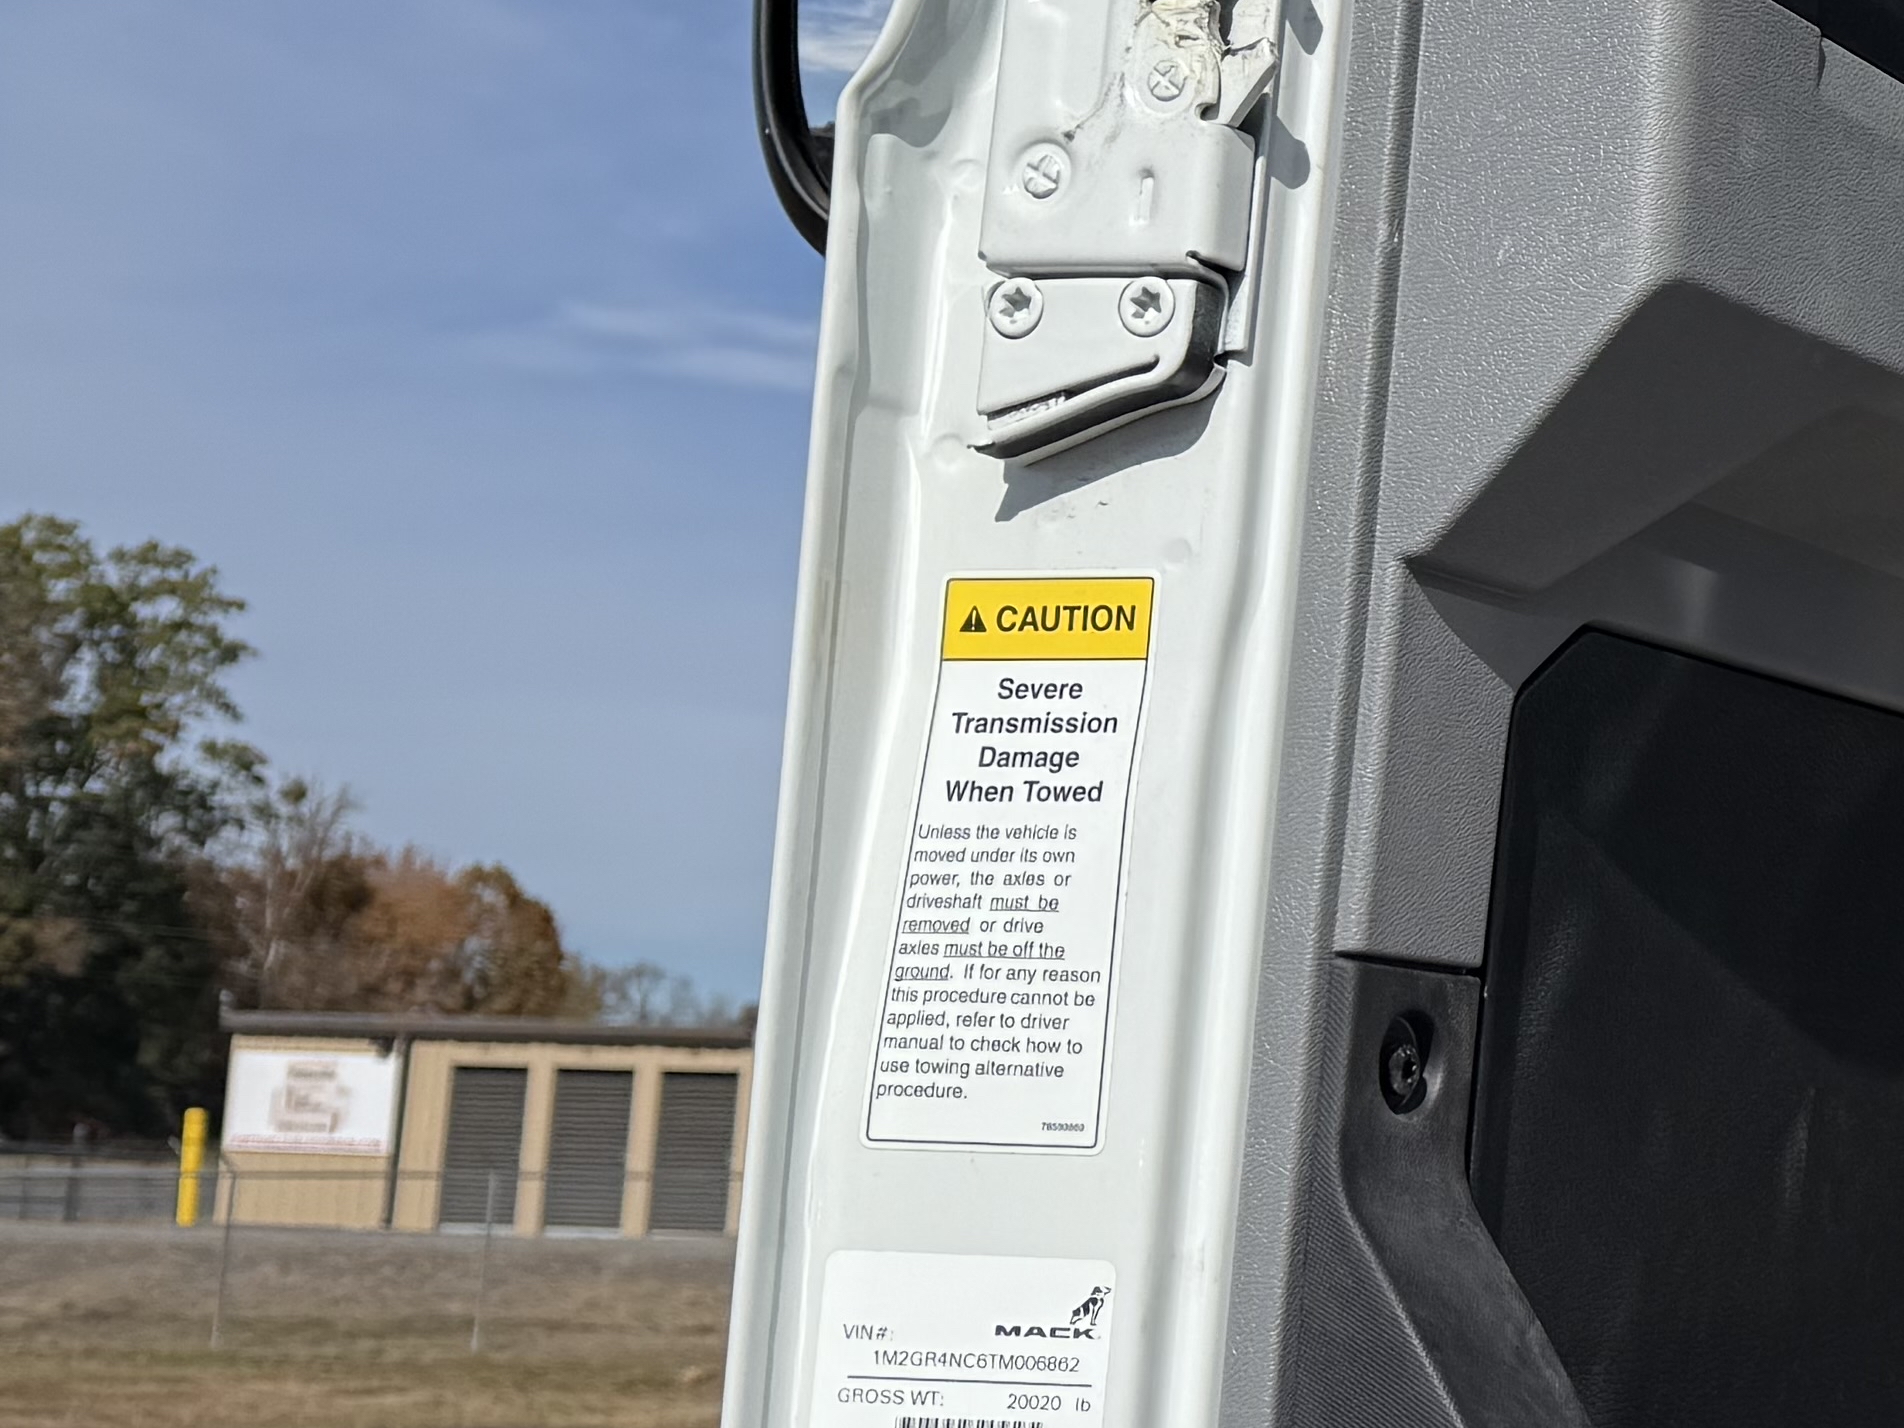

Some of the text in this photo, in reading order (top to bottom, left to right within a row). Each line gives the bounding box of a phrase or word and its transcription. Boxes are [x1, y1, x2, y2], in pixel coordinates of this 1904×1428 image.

[995, 604, 1136, 632] CAUTION
[997, 677, 1083, 700] Severe
[951, 710, 1118, 734] Transmission
[977, 745, 1080, 774] Damage
[945, 779, 1104, 802] When Towed
[917, 823, 1077, 840] Unless the vehicle is
[913, 846, 1075, 863] moved under its own
[908, 870, 1072, 888] power, the axles or
[906, 892, 1059, 911] driveshaft must be
[901, 916, 1044, 934] removed or drive
[897, 939, 1065, 959] axles must be off the
[893, 962, 1101, 985] ground. If for any reason
[890, 986, 1096, 1007] this procedure cannot be
[886, 1009, 1070, 1030] applied, refer to driver
[883, 1033, 1083, 1055] manual to check how to
[879, 1057, 1064, 1079] use towing alternative
[875, 1081, 967, 1100] procedure.
[994, 1324, 1095, 1340] MACK
[837, 1387, 944, 1406] GROSS WT:
[1006, 1392, 1091, 1412] 20020 lb
